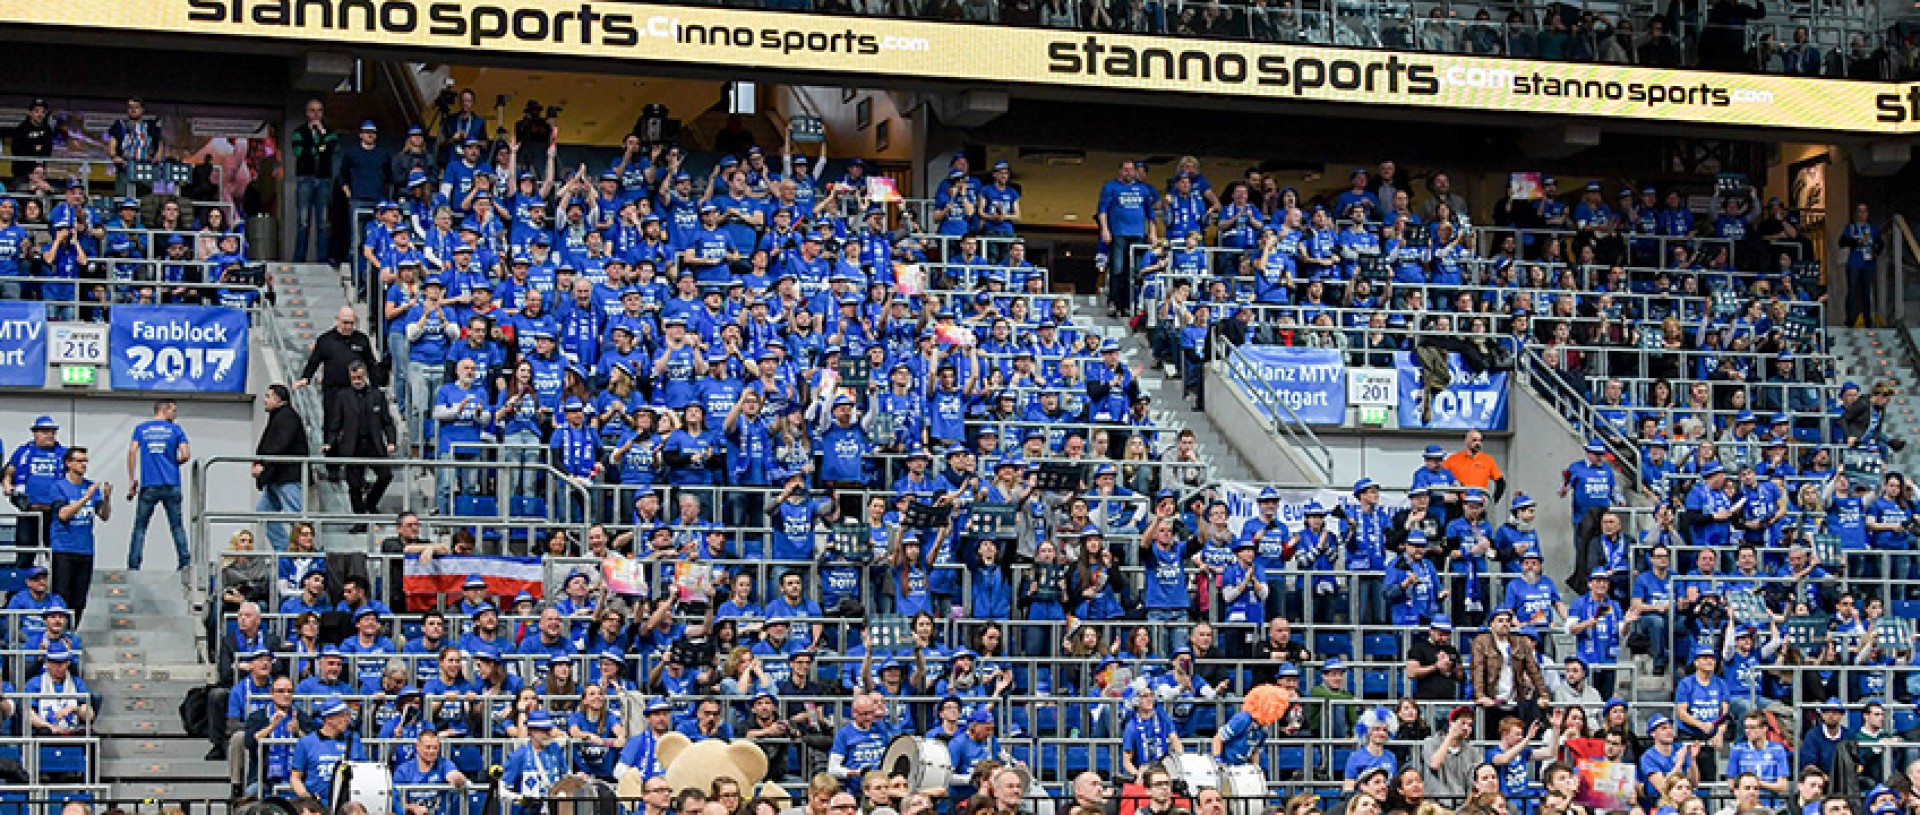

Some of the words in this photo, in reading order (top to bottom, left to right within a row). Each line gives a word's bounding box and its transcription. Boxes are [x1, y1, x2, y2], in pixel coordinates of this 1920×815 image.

[1048, 36, 1247, 83] stanno
[1513, 72, 1622, 100] stanno
[132, 320, 228, 343] Fanblock
[63, 341, 100, 359] 216
[126, 345, 236, 381] 2017
[1299, 364, 1339, 383] MTV
[1362, 385, 1389, 401] 201
